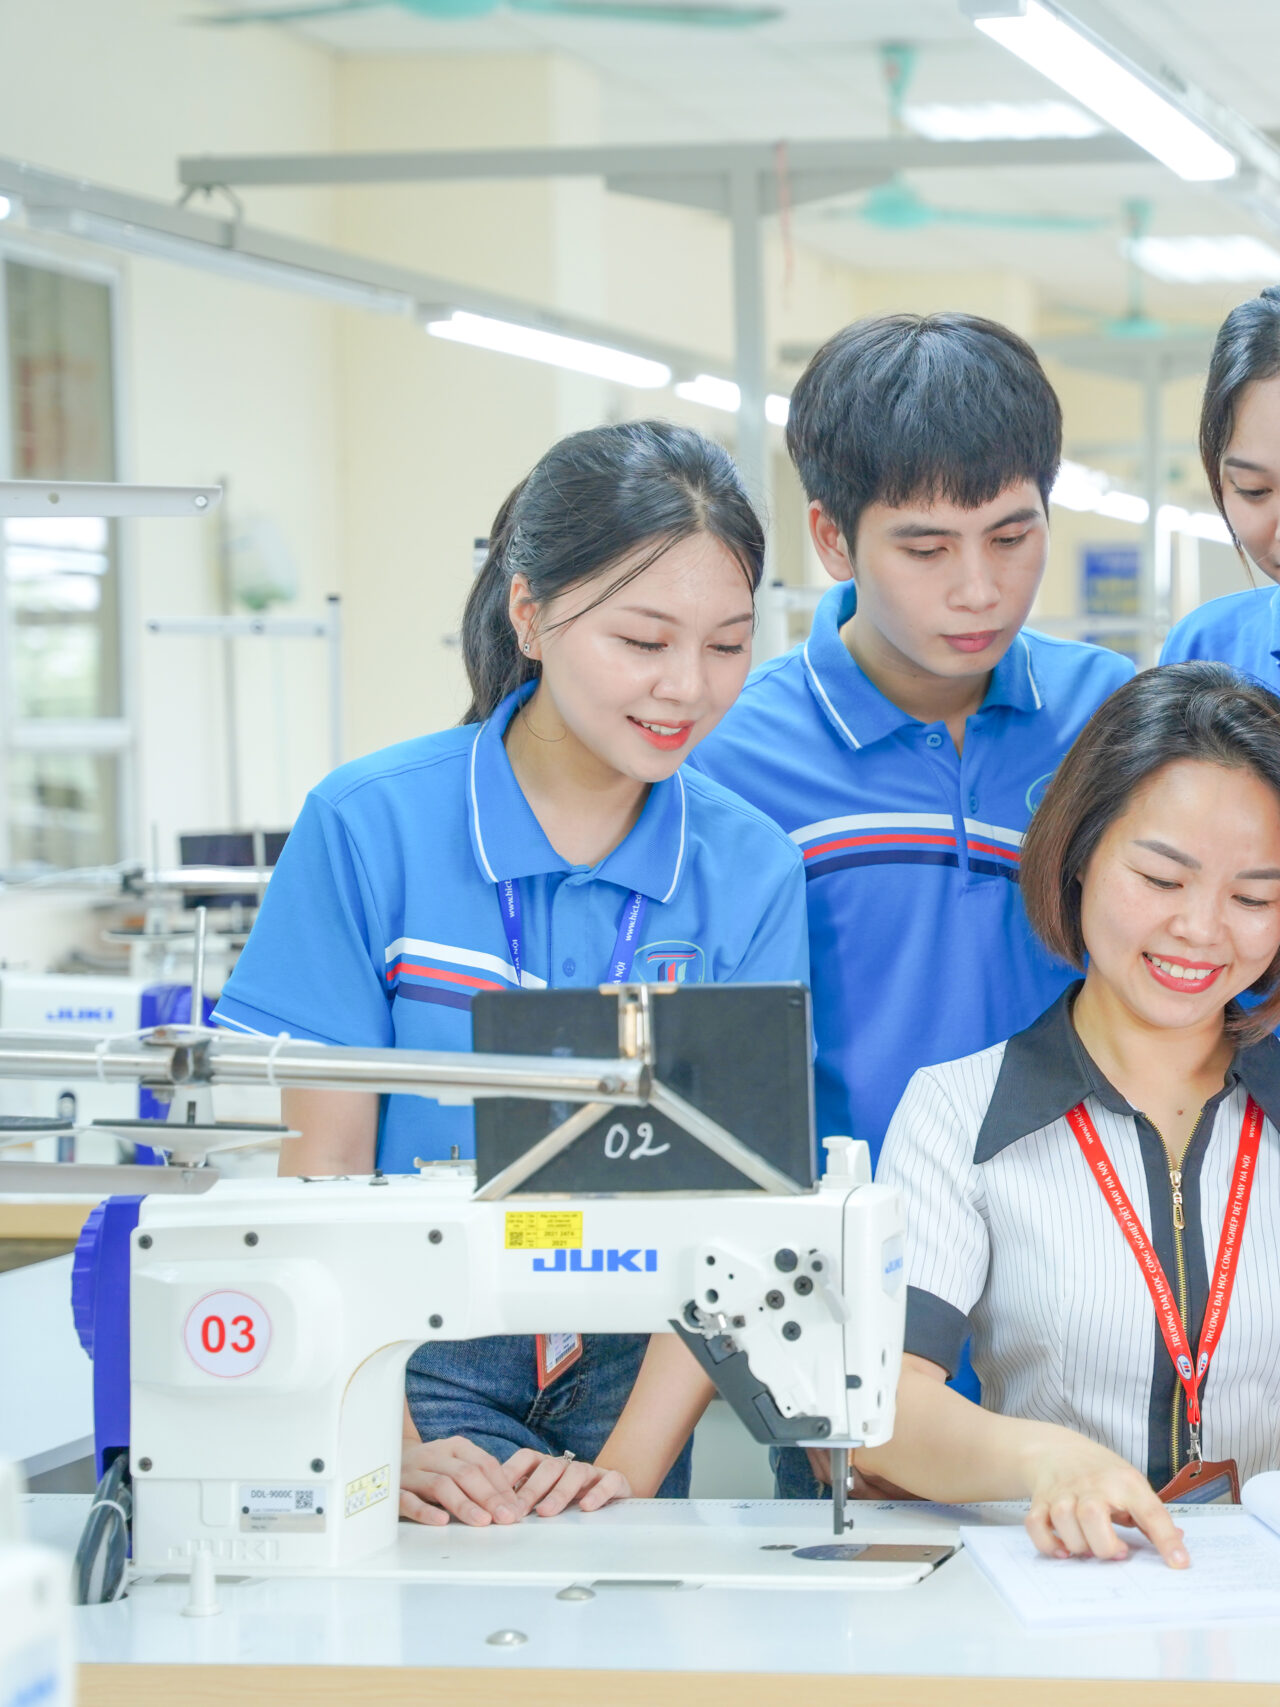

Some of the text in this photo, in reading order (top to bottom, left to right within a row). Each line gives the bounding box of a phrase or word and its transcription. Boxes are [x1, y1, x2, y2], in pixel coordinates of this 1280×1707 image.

[46, 1007, 114, 1022] JUKI
[604, 1122, 671, 1160] 02
[1110, 1190, 1125, 1206] MAY
[1235, 1182, 1246, 1200] MAY
[533, 1249, 658, 1272] JUKI
[1141, 1249, 1157, 1274] CÔNG
[1220, 1246, 1233, 1270] CÔNG
[1152, 1275, 1165, 1294] HỌC
[1217, 1270, 1229, 1289] HỌC
[201, 1314, 256, 1354] 03
[250, 1489, 293, 1499] DDL-9000C
